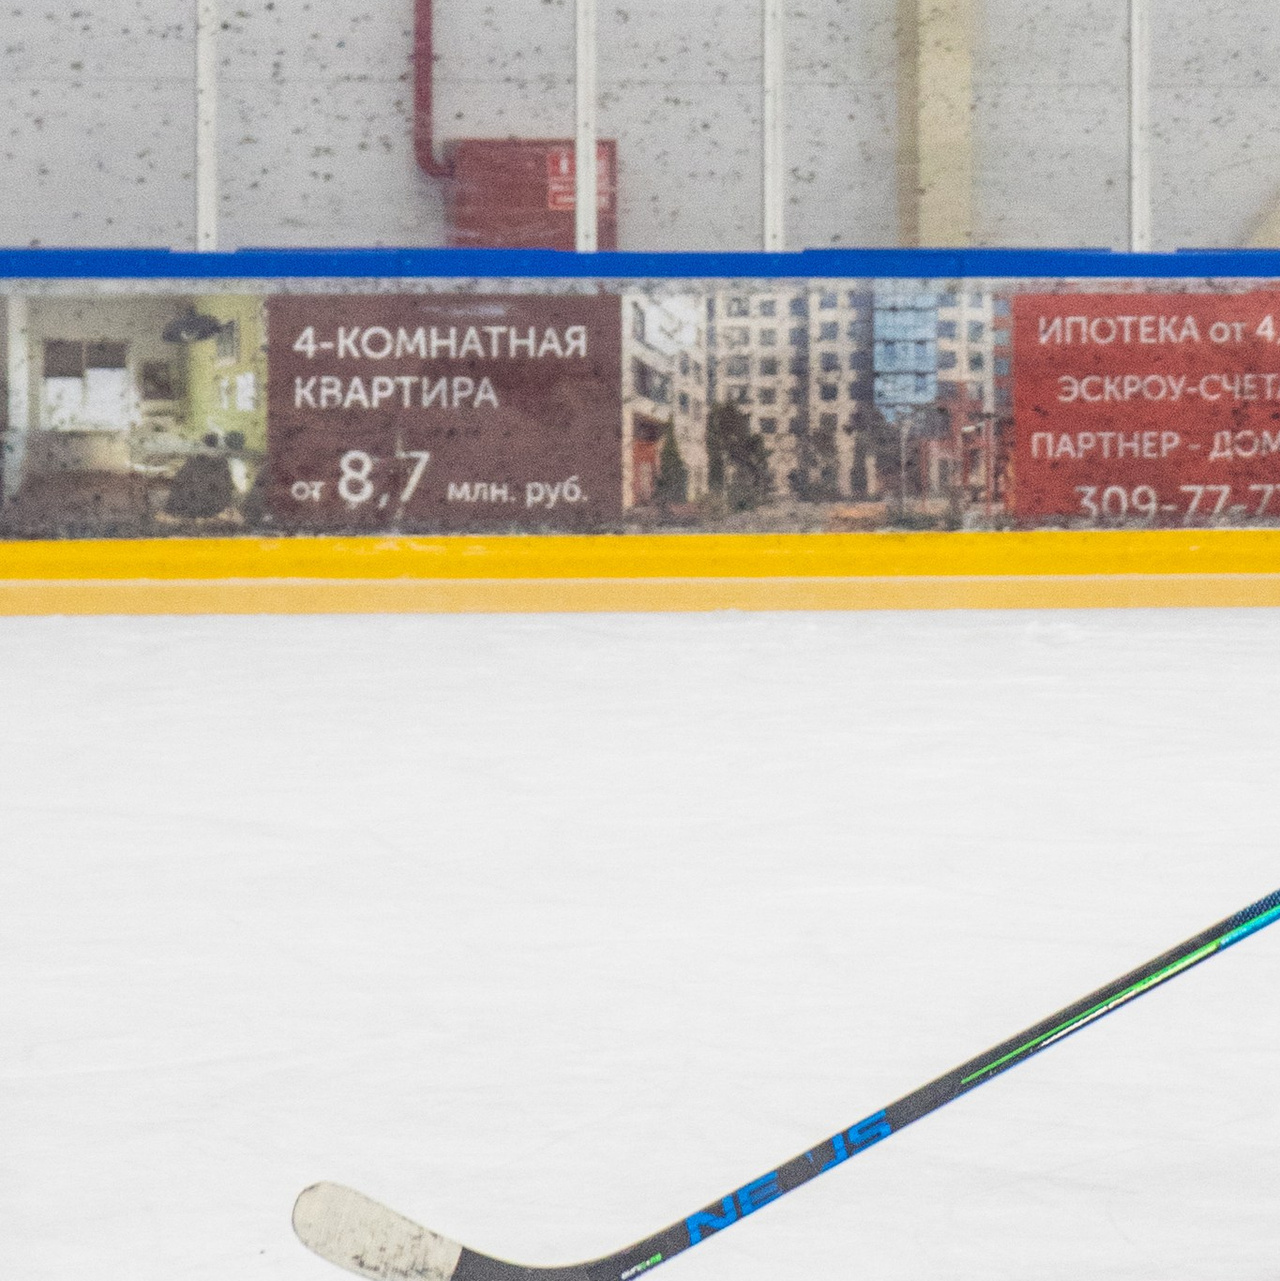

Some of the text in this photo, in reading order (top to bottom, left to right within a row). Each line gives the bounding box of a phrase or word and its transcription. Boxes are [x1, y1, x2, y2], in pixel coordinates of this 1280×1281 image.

[293, 325, 588, 360] 4-КОМНАТНАЯ
[1037, 314, 1201, 345] ИПОТЕКА
[1208, 321, 1248, 344] от
[294, 375, 499, 410] КВАРТИРА
[1030, 430, 1181, 459] ПАРТНЕР
[291, 450, 588, 509] от 8,7 млн. руб.
[686, 1107, 892, 1248] NEUS
